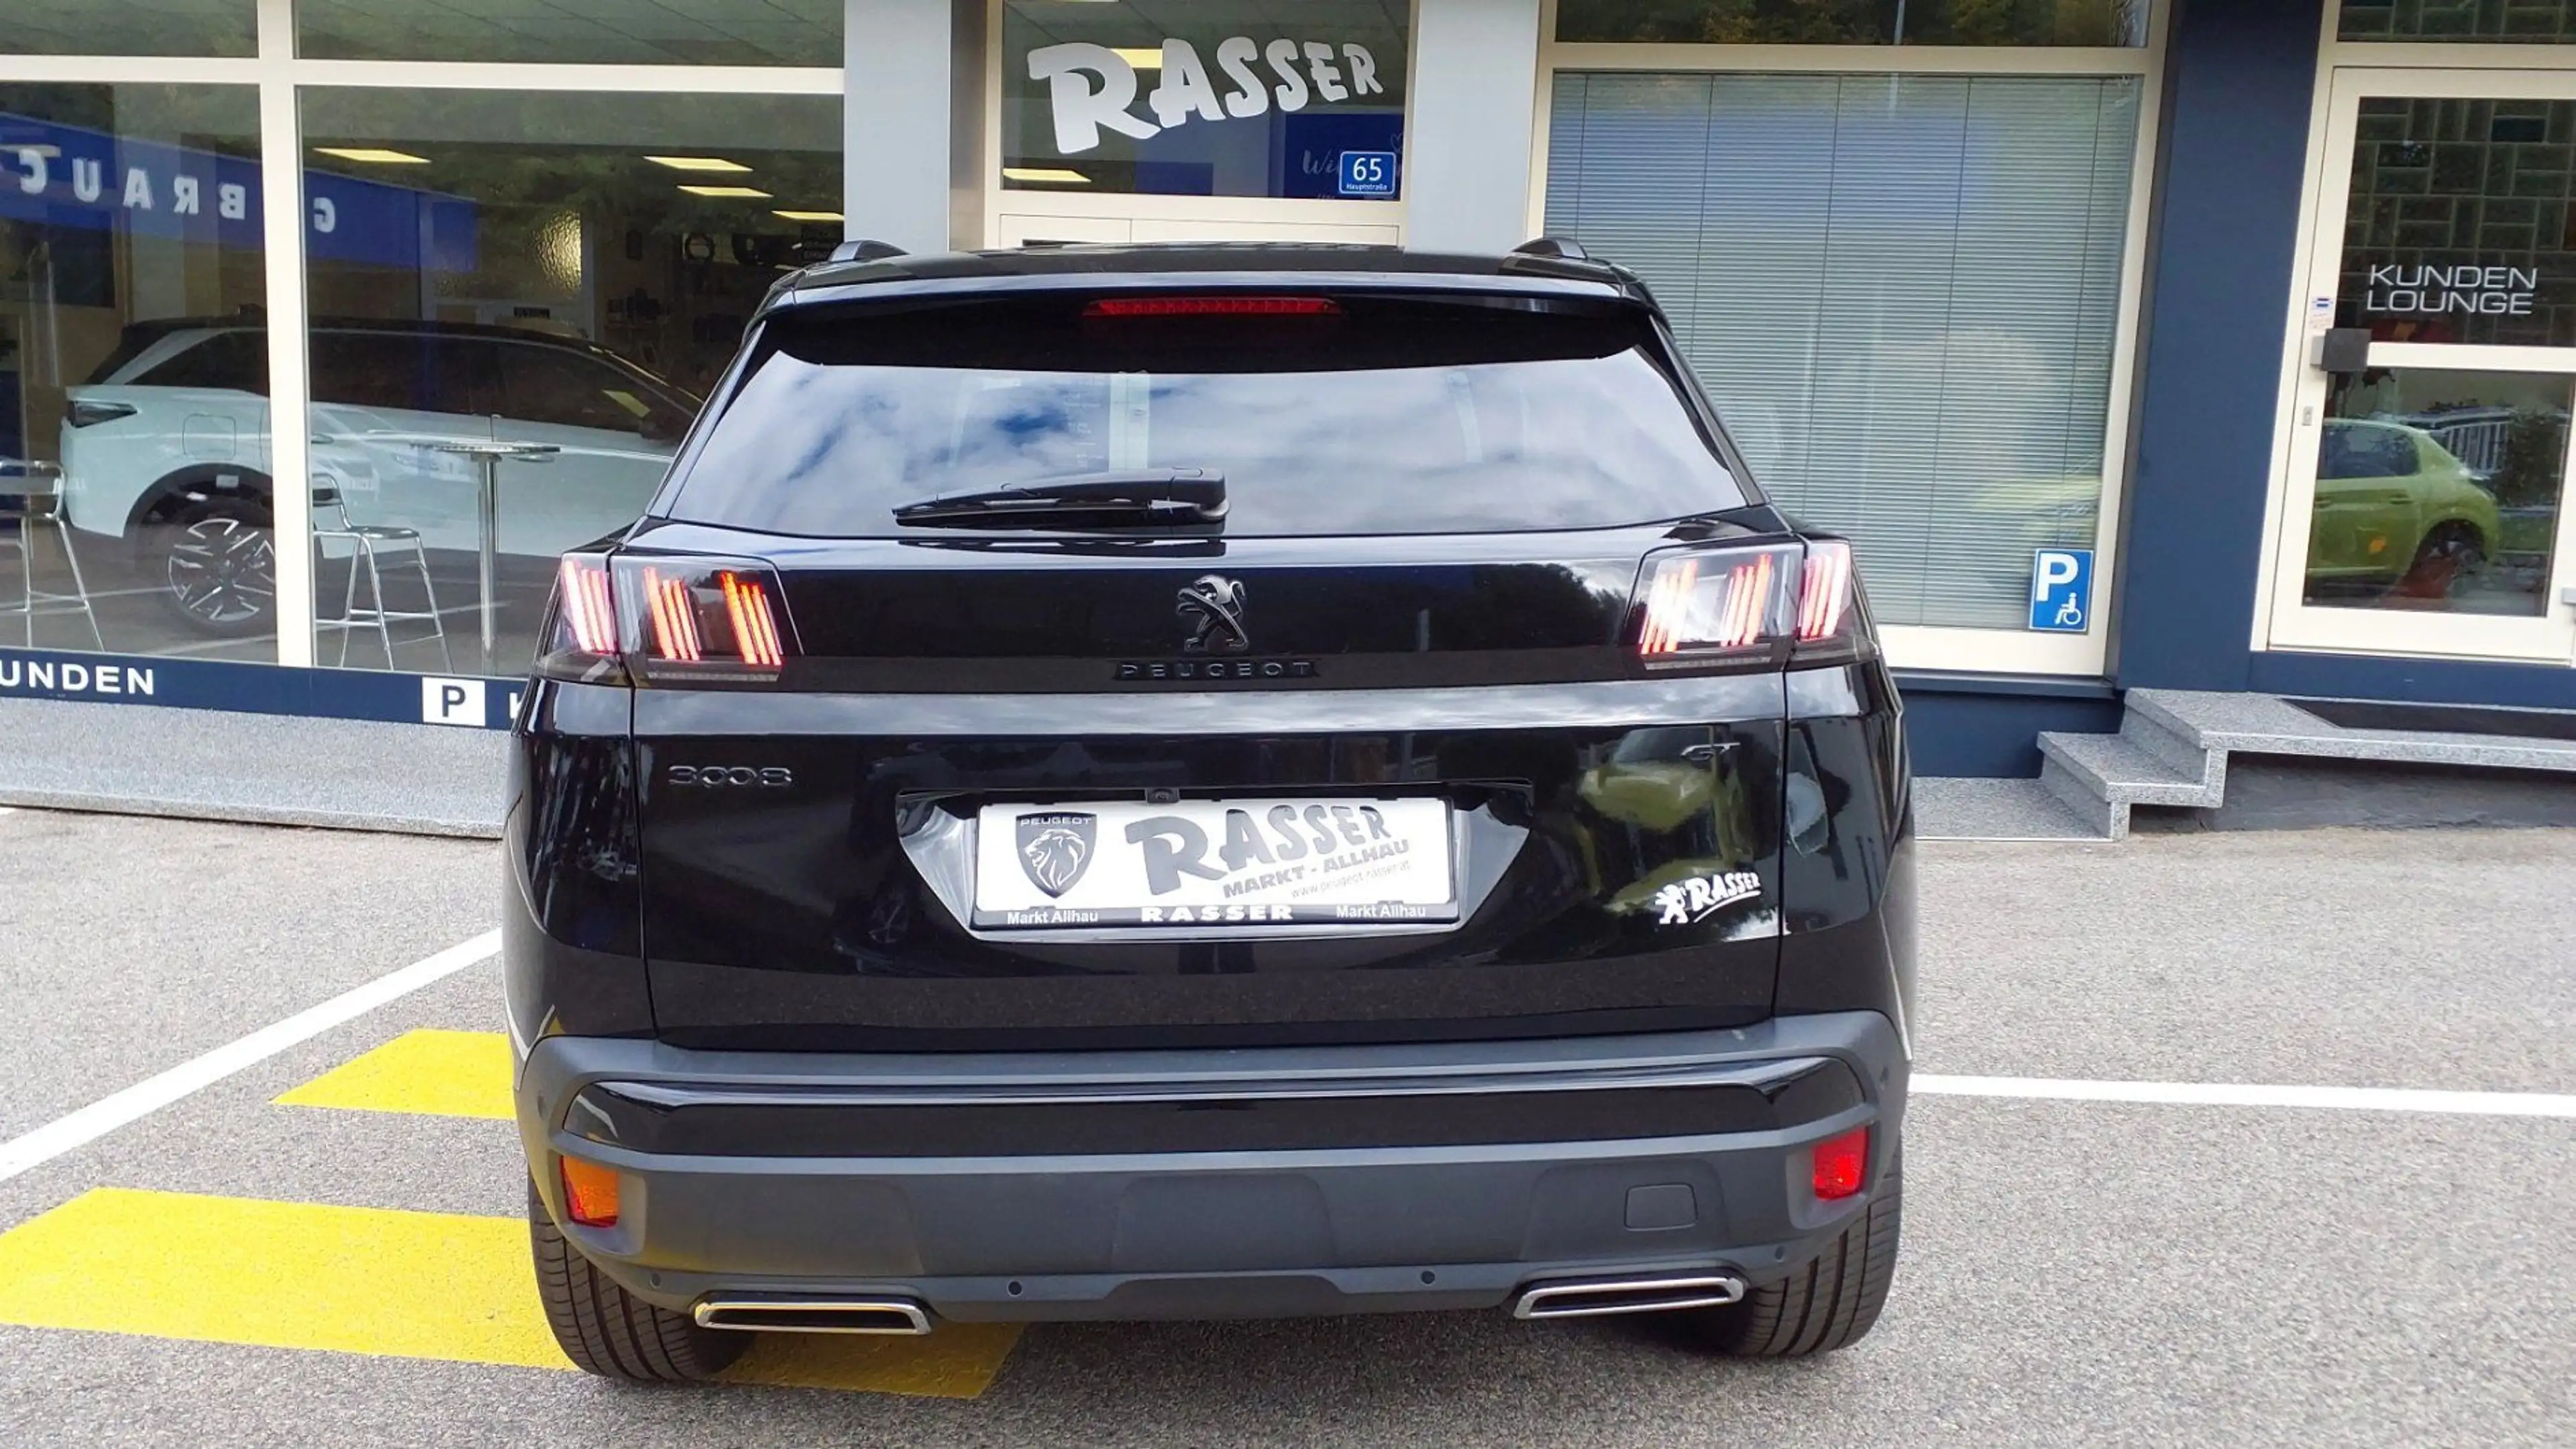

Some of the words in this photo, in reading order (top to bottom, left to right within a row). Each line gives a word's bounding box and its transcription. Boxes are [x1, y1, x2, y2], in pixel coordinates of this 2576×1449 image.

[1028, 36, 1384, 154] RASSER
[1353, 158, 1382, 181] 65
[2369, 264, 2538, 289] KUNDEN
[2365, 290, 2534, 315] LOUNGE
[2035, 552, 2079, 602] P
[1121, 661, 1311, 679] PEUGEOT
[441, 684, 466, 718] P
[1680, 742, 1741, 761] GT
[668, 765, 792, 788] 3008
[1020, 816, 1092, 826] PEUGEOT
[1124, 804, 1391, 895] RASSER
[1223, 865, 1305, 898] MARKT
[1324, 839, 1409, 873] ALLHAU
[1685, 872, 1761, 912] RASSER
[1007, 910, 1049, 924] Markt
[1051, 910, 1099, 924] Allhau
[1140, 905, 1293, 923] RASSER
[1336, 904, 1376, 918] Markt
[1379, 904, 1426, 918] Allhau
